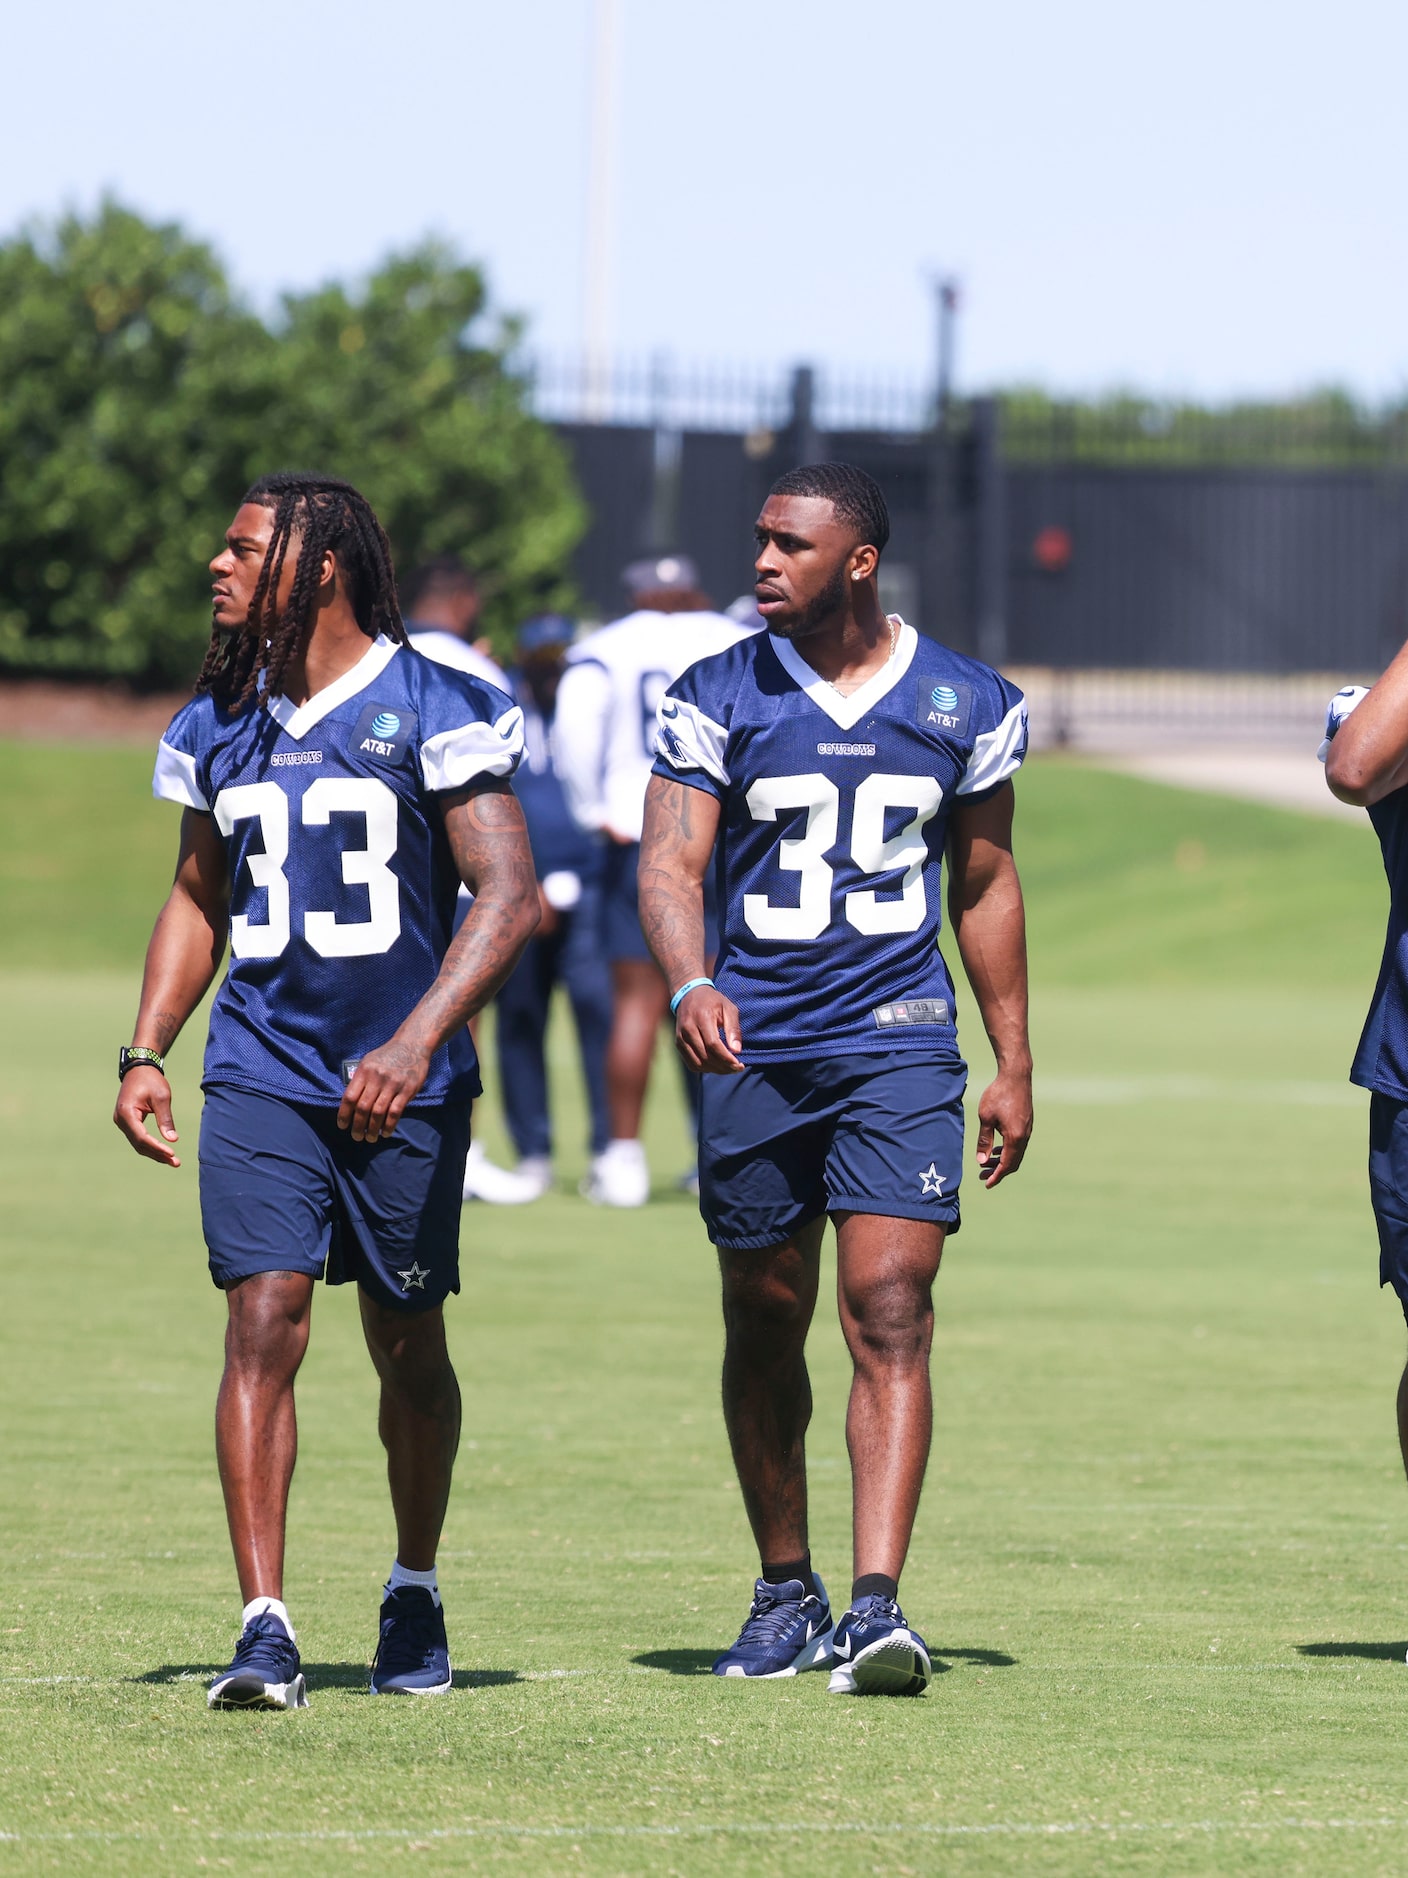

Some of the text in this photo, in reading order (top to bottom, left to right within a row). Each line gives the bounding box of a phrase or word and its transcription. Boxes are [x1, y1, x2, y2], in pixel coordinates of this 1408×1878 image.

[926, 711, 960, 729] AT&T
[360, 738, 395, 757] AT&T
[817, 743, 876, 755] COWBOYS
[271, 751, 322, 766] COWBOYS
[743, 772, 943, 940] 39
[214, 777, 401, 960] 33
